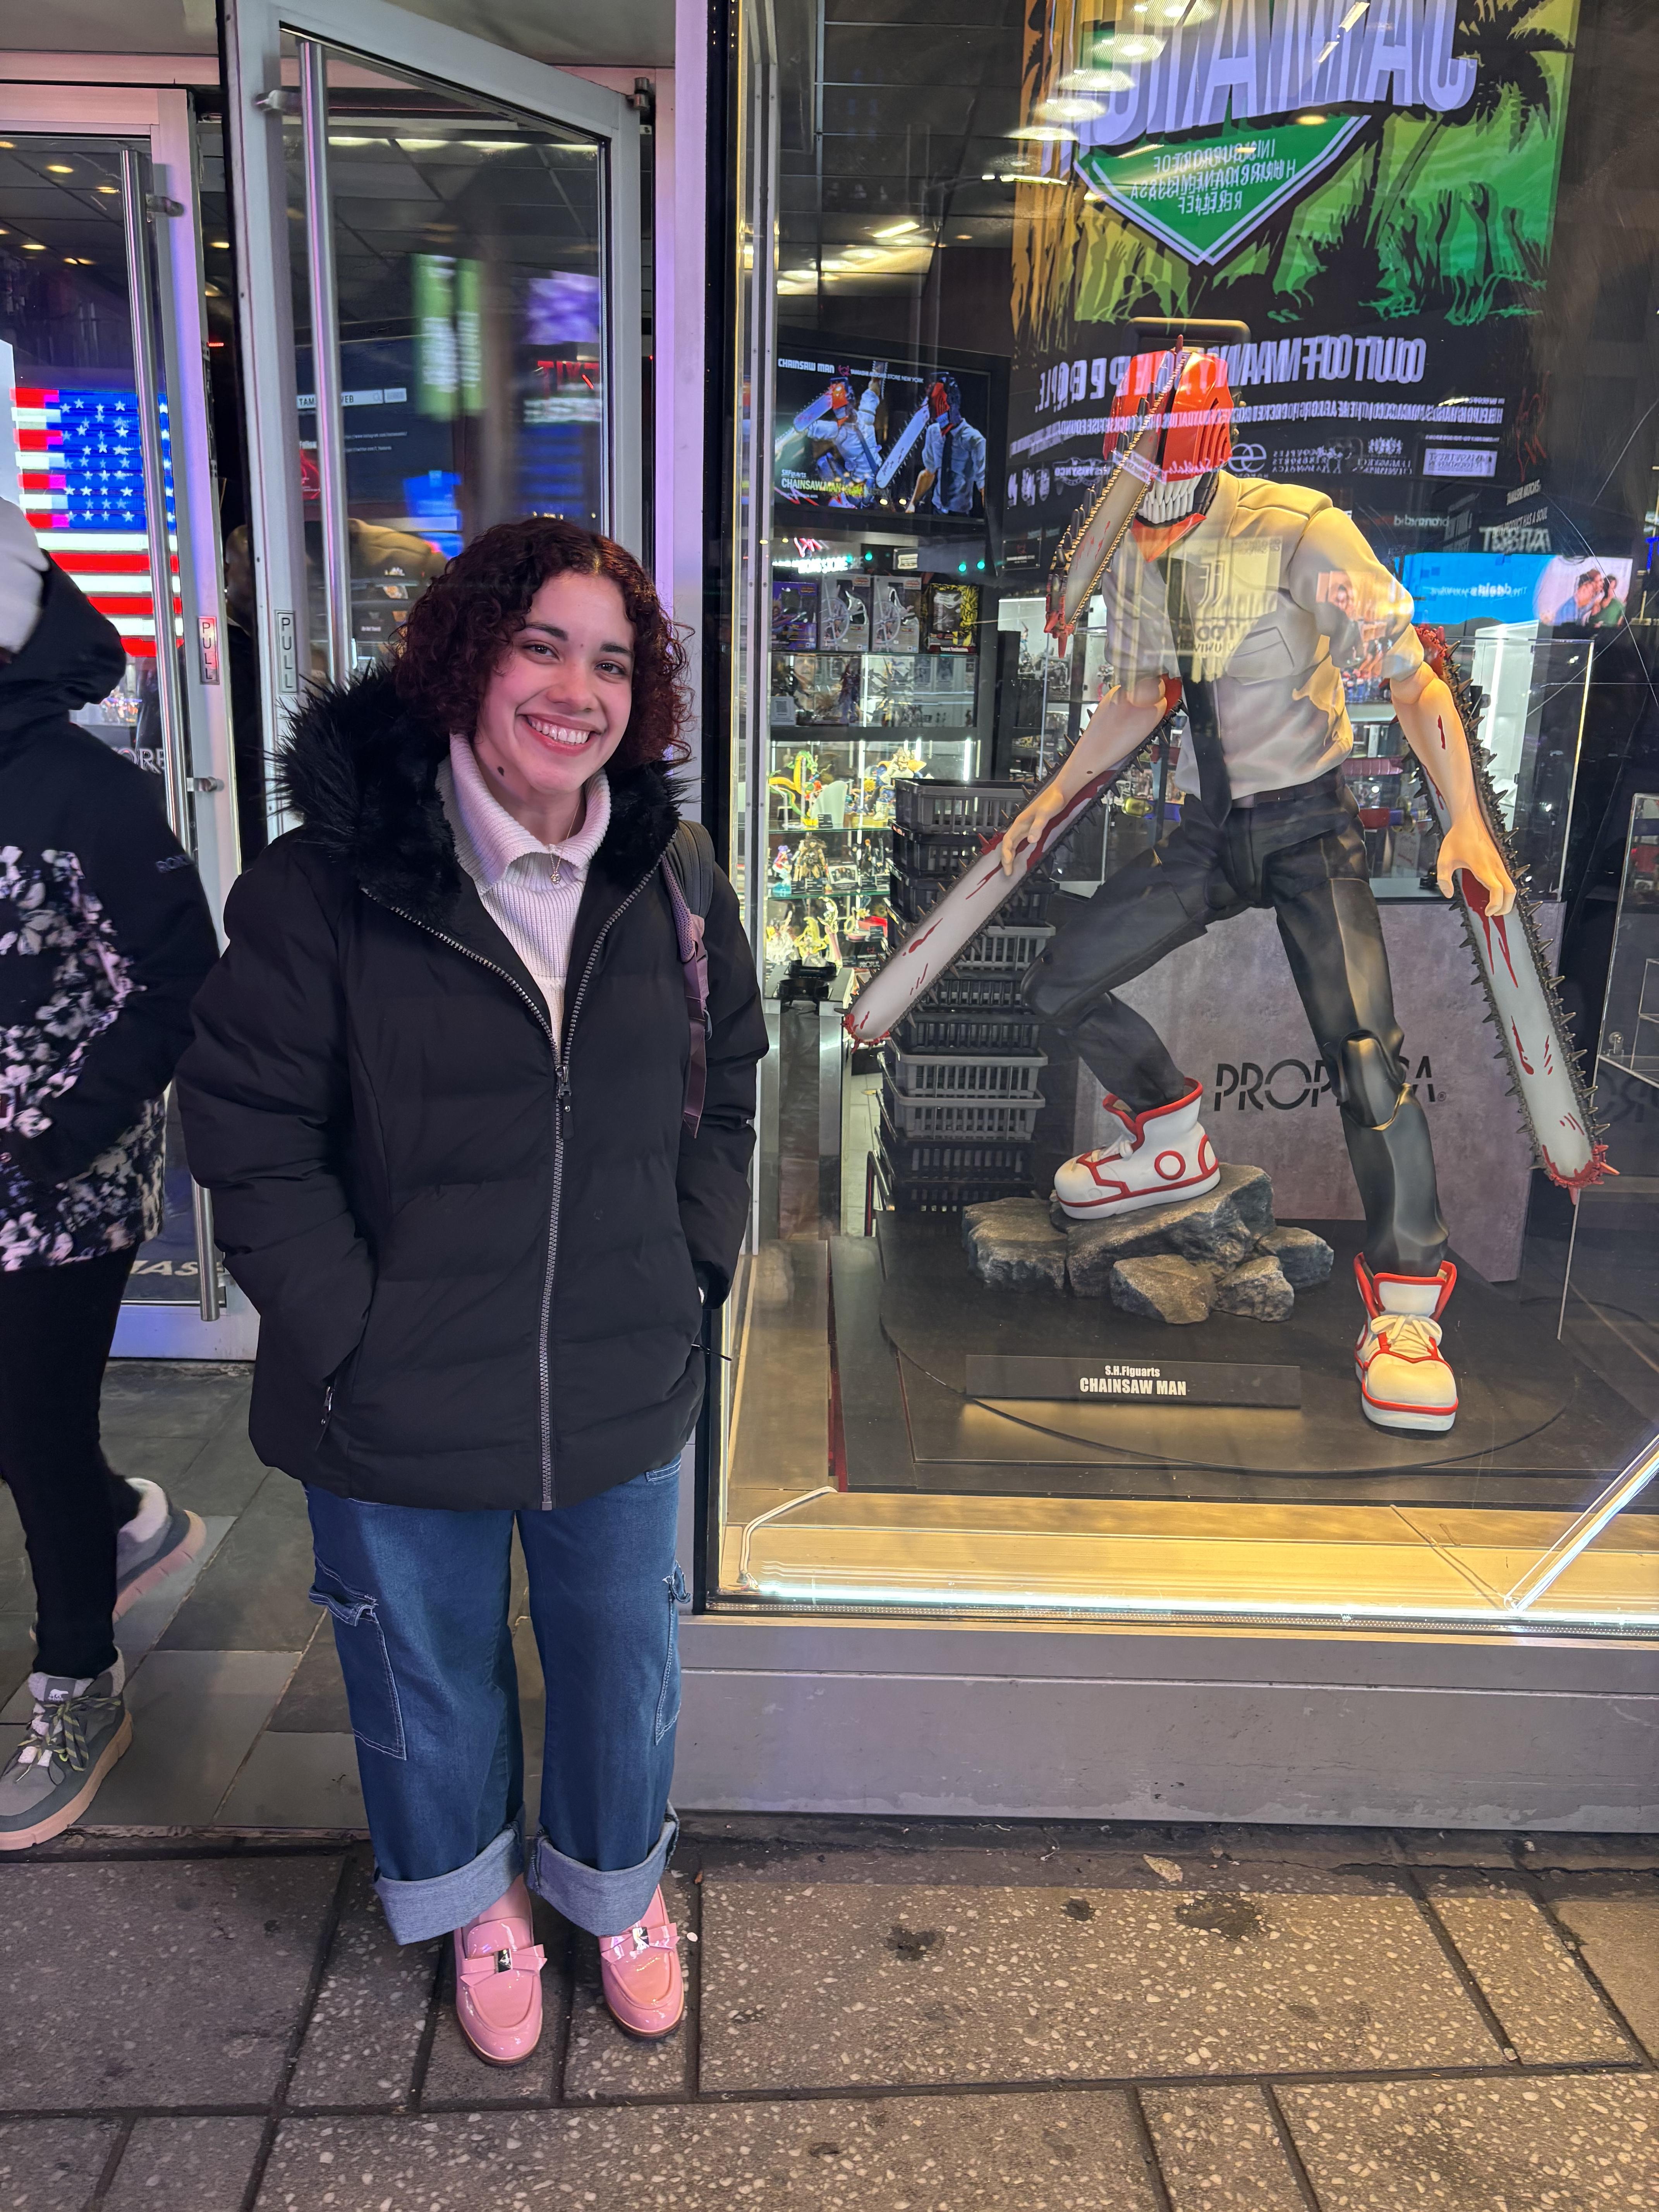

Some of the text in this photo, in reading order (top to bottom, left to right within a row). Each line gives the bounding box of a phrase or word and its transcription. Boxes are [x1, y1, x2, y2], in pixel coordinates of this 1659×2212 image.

[778, 358, 835, 374] CHAINSAW MAN
[202, 622, 213, 680] PULL
[282, 617, 293, 688] PULL
[1214, 1056, 1436, 1111] PROPA
[1080, 1377, 1187, 1396] CHAINSAW MAN
[1105, 1365, 1160, 1377] S.H.Figuarts
